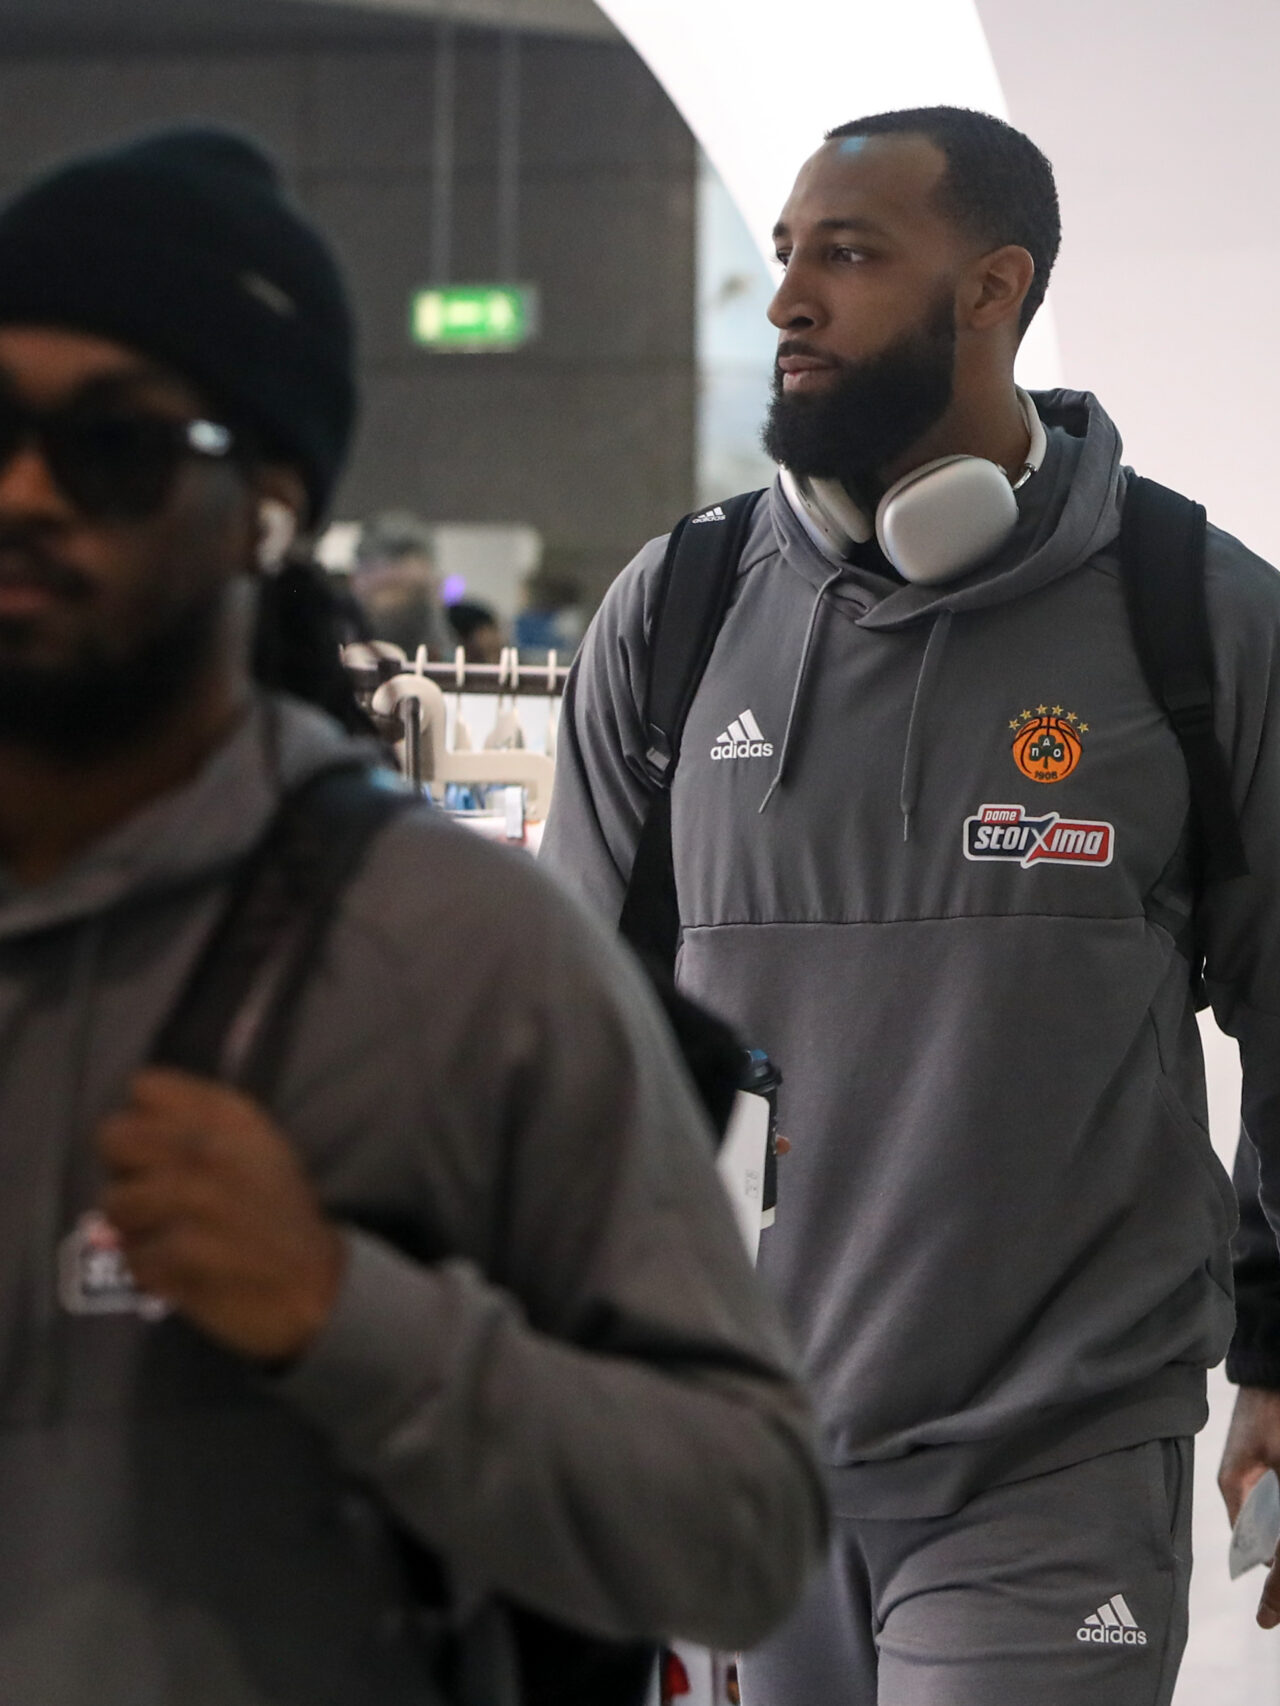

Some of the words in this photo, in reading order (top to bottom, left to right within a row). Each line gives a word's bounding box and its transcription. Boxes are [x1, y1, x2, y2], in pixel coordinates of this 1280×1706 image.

[710, 740, 774, 760] adidas
[984, 809, 1018, 823] pame
[1077, 1625, 1148, 1645] adidas
